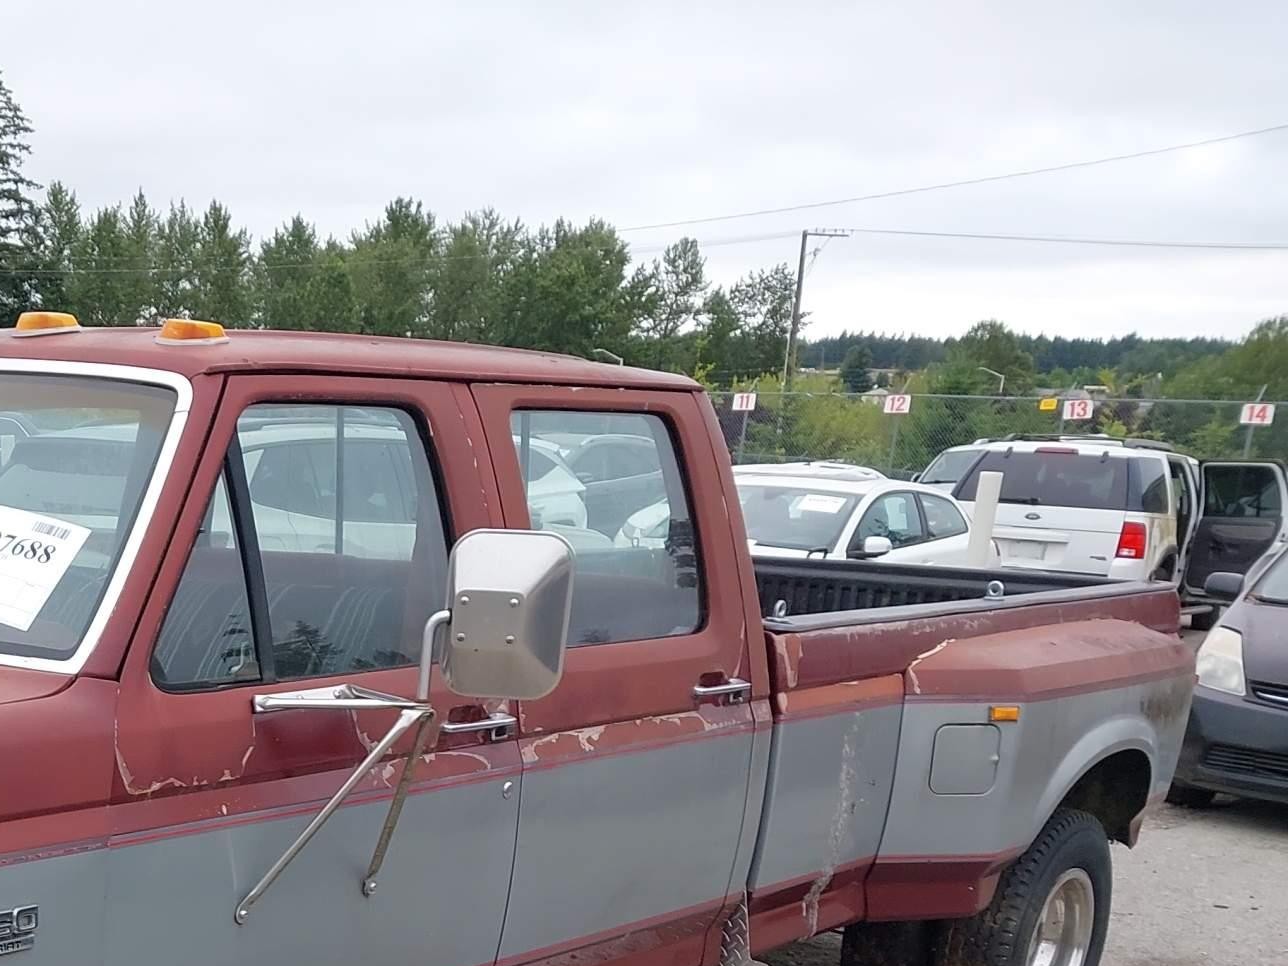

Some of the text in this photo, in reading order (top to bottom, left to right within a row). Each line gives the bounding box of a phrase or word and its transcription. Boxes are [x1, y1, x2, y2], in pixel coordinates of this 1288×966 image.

[739, 393, 751, 409] 11
[889, 396, 906, 412] 12
[1068, 401, 1088, 417] 13
[1247, 405, 1268, 422] 14
